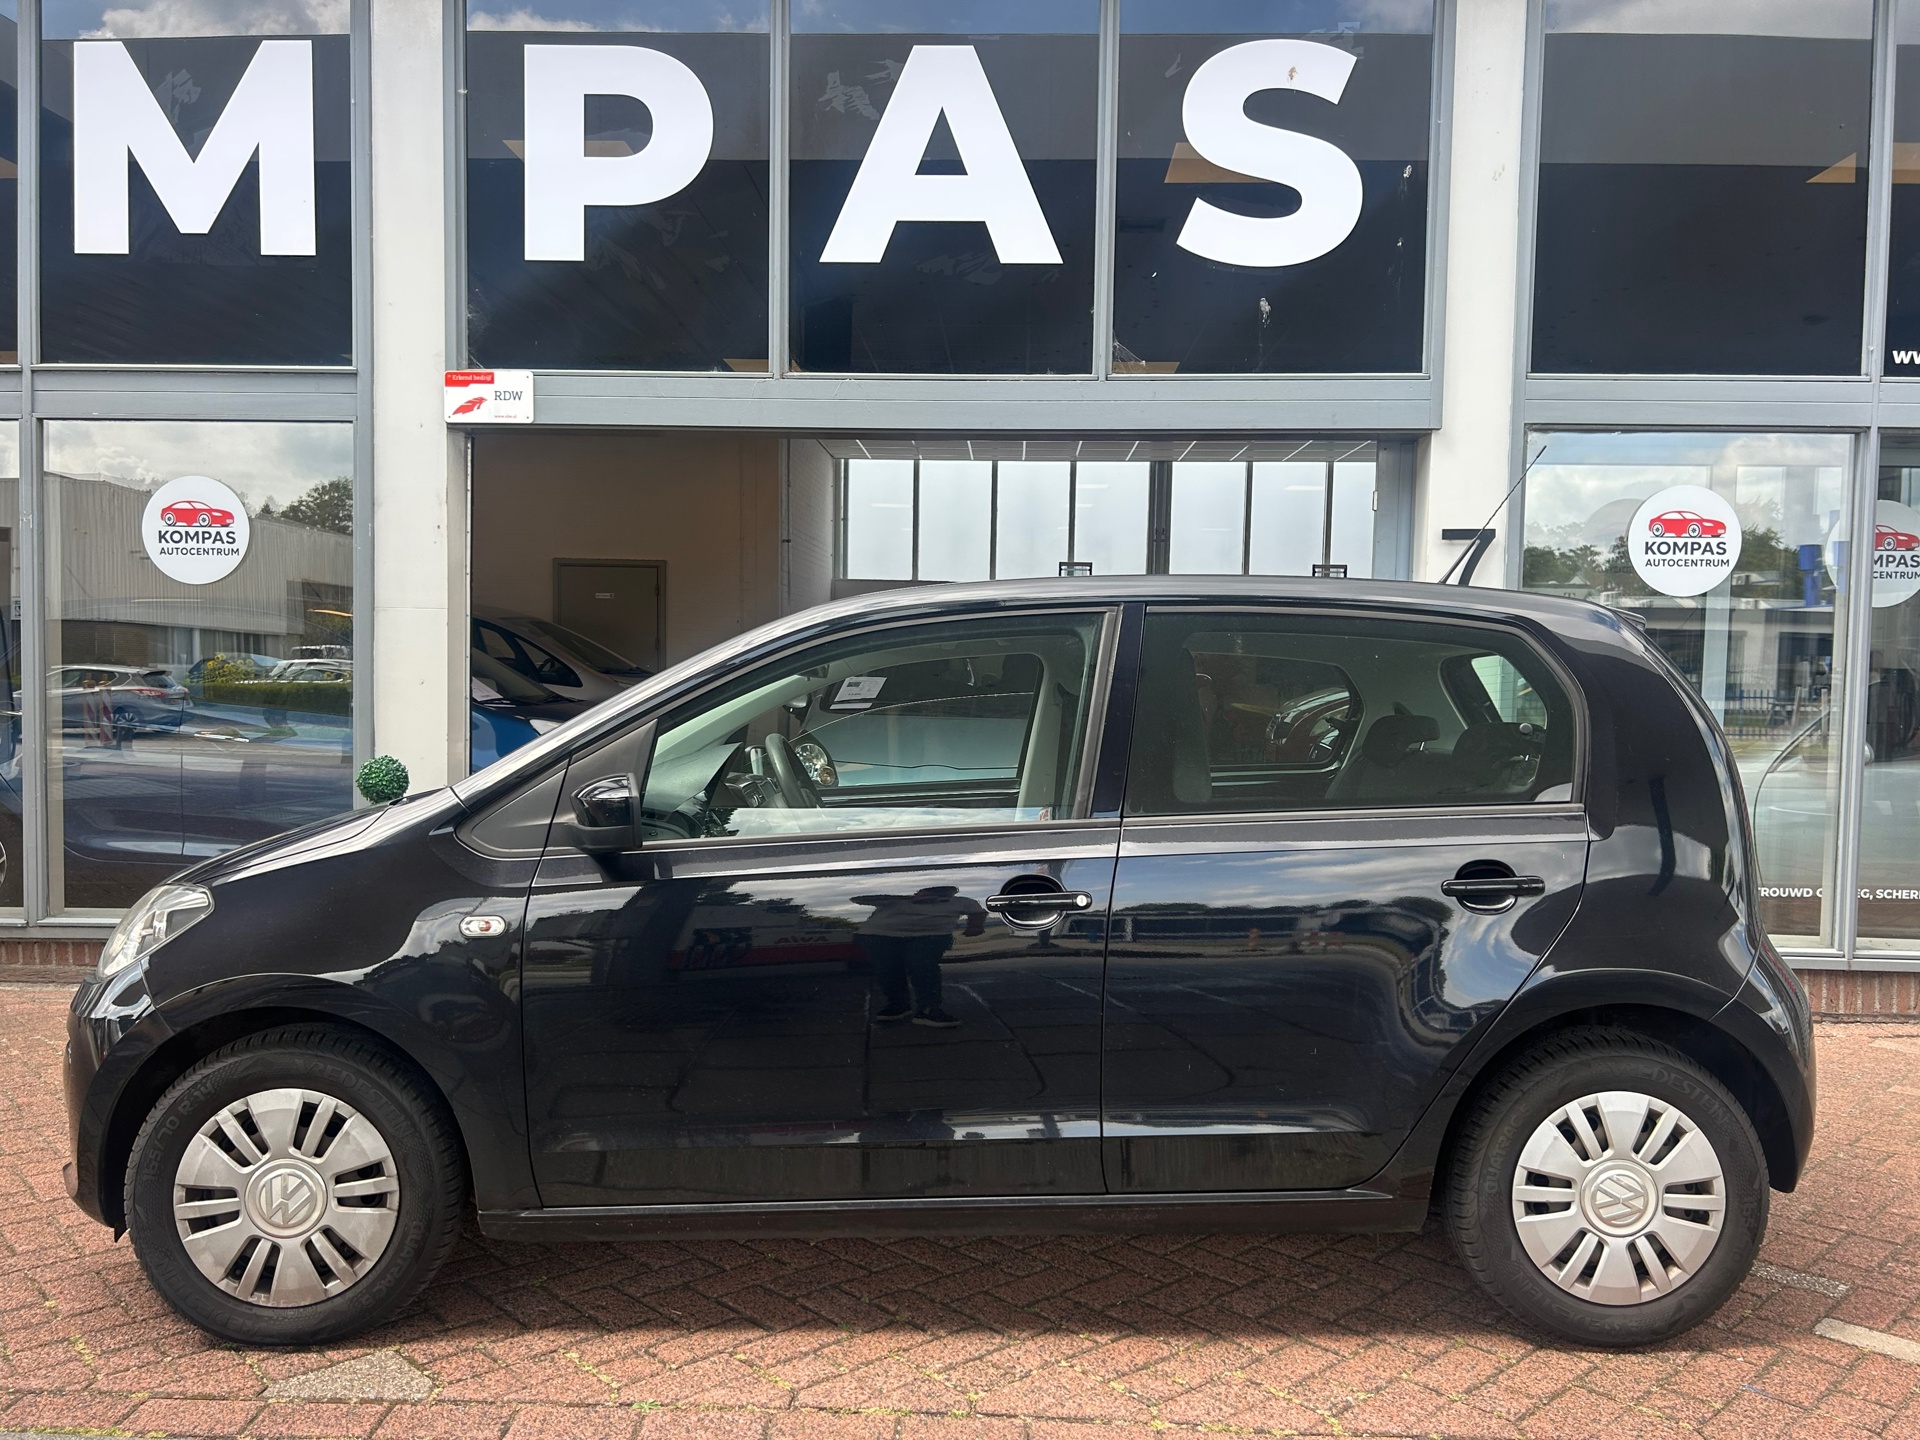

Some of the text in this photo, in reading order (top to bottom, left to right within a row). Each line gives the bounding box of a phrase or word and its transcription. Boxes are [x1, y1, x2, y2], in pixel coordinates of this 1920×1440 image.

[494, 390, 523, 401] RDW
[158, 530, 237, 545] KOMPAS
[159, 547, 240, 556] AUTOCENTRUM
[1644, 541, 1727, 556] KOMPAS
[1442, 528, 1496, 586] 7
[1645, 558, 1730, 568] AUTOCENTRUM
[1875, 889, 1920, 900] SCHER
